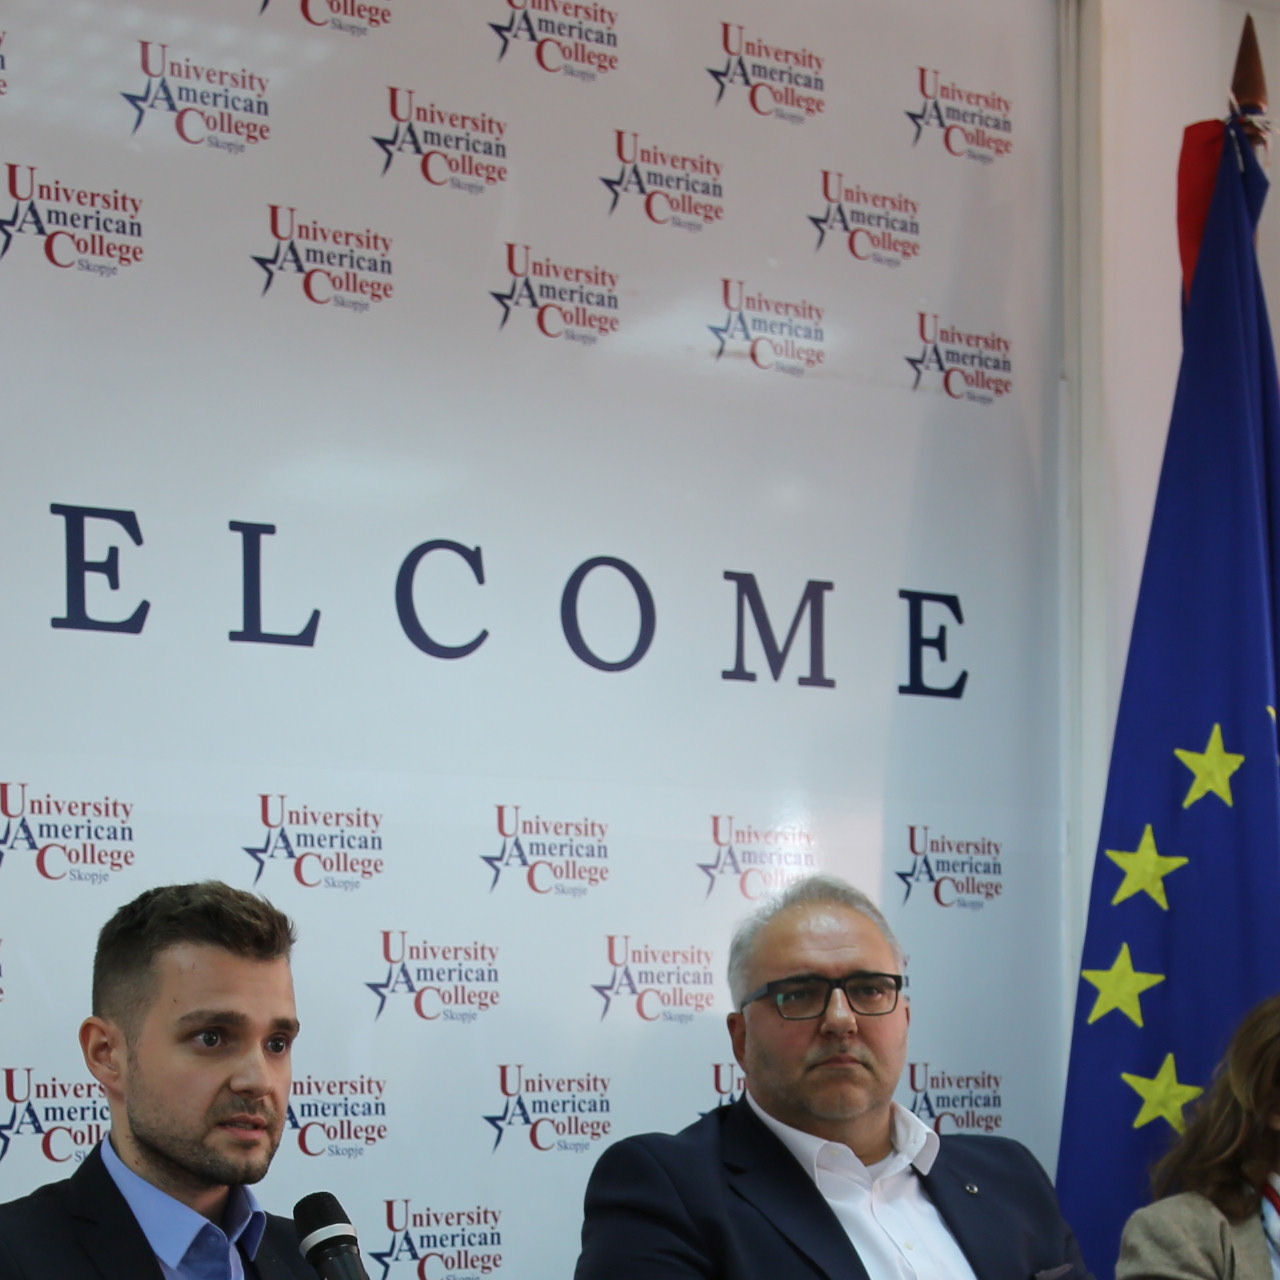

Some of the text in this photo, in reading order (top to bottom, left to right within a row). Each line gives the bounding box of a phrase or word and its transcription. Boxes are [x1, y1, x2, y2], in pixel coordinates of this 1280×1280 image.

[301, 0, 391, 27] College
[506, 0, 618, 30] niversity
[512, 9, 617, 48] American
[536, 38, 618, 73] College
[720, 21, 824, 75] University
[137, 39, 269, 98] University
[728, 55, 824, 92] American
[148, 76, 269, 117] American
[749, 83, 824, 116] College
[917, 66, 1011, 117] University
[175, 108, 270, 144] College
[386, 86, 507, 141] University
[924, 98, 1011, 133] American
[396, 121, 506, 159] American
[613, 129, 723, 181] University
[944, 125, 1011, 156] College
[421, 151, 507, 186] College
[622, 162, 723, 198] American
[4, 162, 143, 219] University
[645, 191, 723, 224] College
[820, 169, 919, 219] University
[16, 200, 143, 238] American
[267, 203, 392, 257] University
[828, 201, 919, 235] American
[44, 231, 143, 268] College
[277, 239, 392, 275] American
[848, 228, 919, 260] College
[504, 242, 618, 293] University
[303, 269, 393, 304] College
[513, 276, 618, 310] American
[720, 277, 823, 326] University
[537, 304, 619, 338] College
[728, 309, 823, 342] American
[917, 311, 1012, 357] University
[749, 337, 823, 370] College
[924, 342, 1012, 373] American
[943, 368, 1012, 399] College
[257, 794, 383, 834] University
[494, 804, 608, 843] University
[7, 816, 134, 851] American
[268, 826, 383, 859] American
[711, 815, 814, 852] University
[907, 825, 1001, 860] University
[36, 843, 134, 880] College
[503, 835, 608, 867] American
[719, 845, 814, 874] American
[914, 853, 1001, 882] American
[69, 869, 109, 884] Skopje
[294, 852, 383, 887] College
[324, 877, 360, 891] Skopje
[527, 860, 608, 894] College
[934, 876, 1001, 907] College
[379, 930, 499, 966] University
[605, 935, 711, 969] University
[389, 961, 499, 993] American
[613, 964, 711, 995] American
[414, 985, 499, 1020] College
[443, 1009, 477, 1023] Skopje
[636, 987, 712, 1021] College
[2, 1068, 106, 1104] Univers
[291, 1075, 386, 1101] niversity
[497, 1066, 610, 1097] University
[908, 1063, 1002, 1094] University
[13, 1100, 109, 1134] Americ
[506, 1094, 610, 1125] American
[916, 1090, 1002, 1118] American
[298, 1120, 386, 1156] College
[529, 1116, 610, 1150] College
[934, 1111, 1002, 1134] College
[42, 1125, 109, 1162] Coll
[328, 1145, 363, 1158] Skopje
[556, 1139, 589, 1152] Skopje
[383, 1199, 501, 1232] University
[393, 1228, 501, 1261] American
